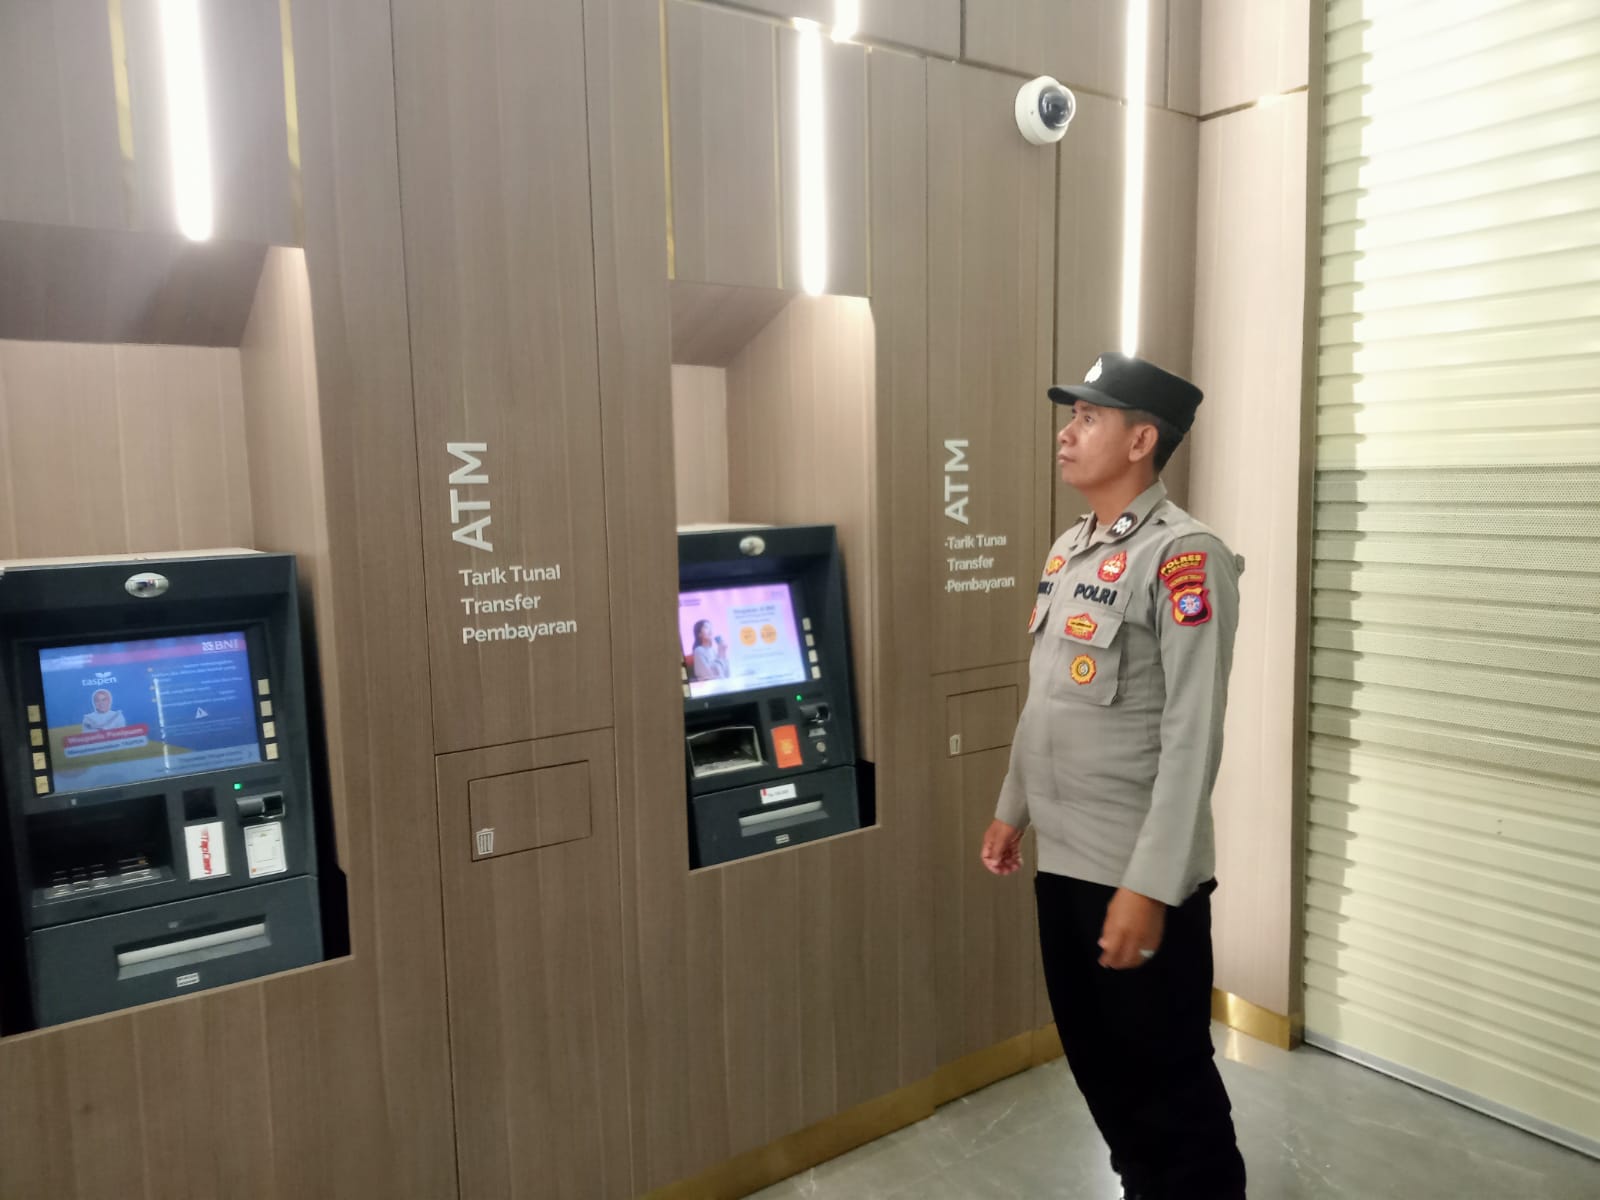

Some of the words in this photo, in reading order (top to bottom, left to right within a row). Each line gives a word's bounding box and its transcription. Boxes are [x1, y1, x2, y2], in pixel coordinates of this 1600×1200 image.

[944, 439, 969, 525] ATM
[446, 442, 494, 553] ATM
[947, 555, 994, 572] Transfer
[458, 567, 508, 587] Tarik
[509, 564, 561, 583] Tunai
[946, 576, 1015, 593] Pembayaran
[460, 593, 541, 615] Transfer
[1074, 583, 1118, 606] POLRI
[462, 620, 578, 645] Pembayaran
[214, 638, 239, 651] BNI
